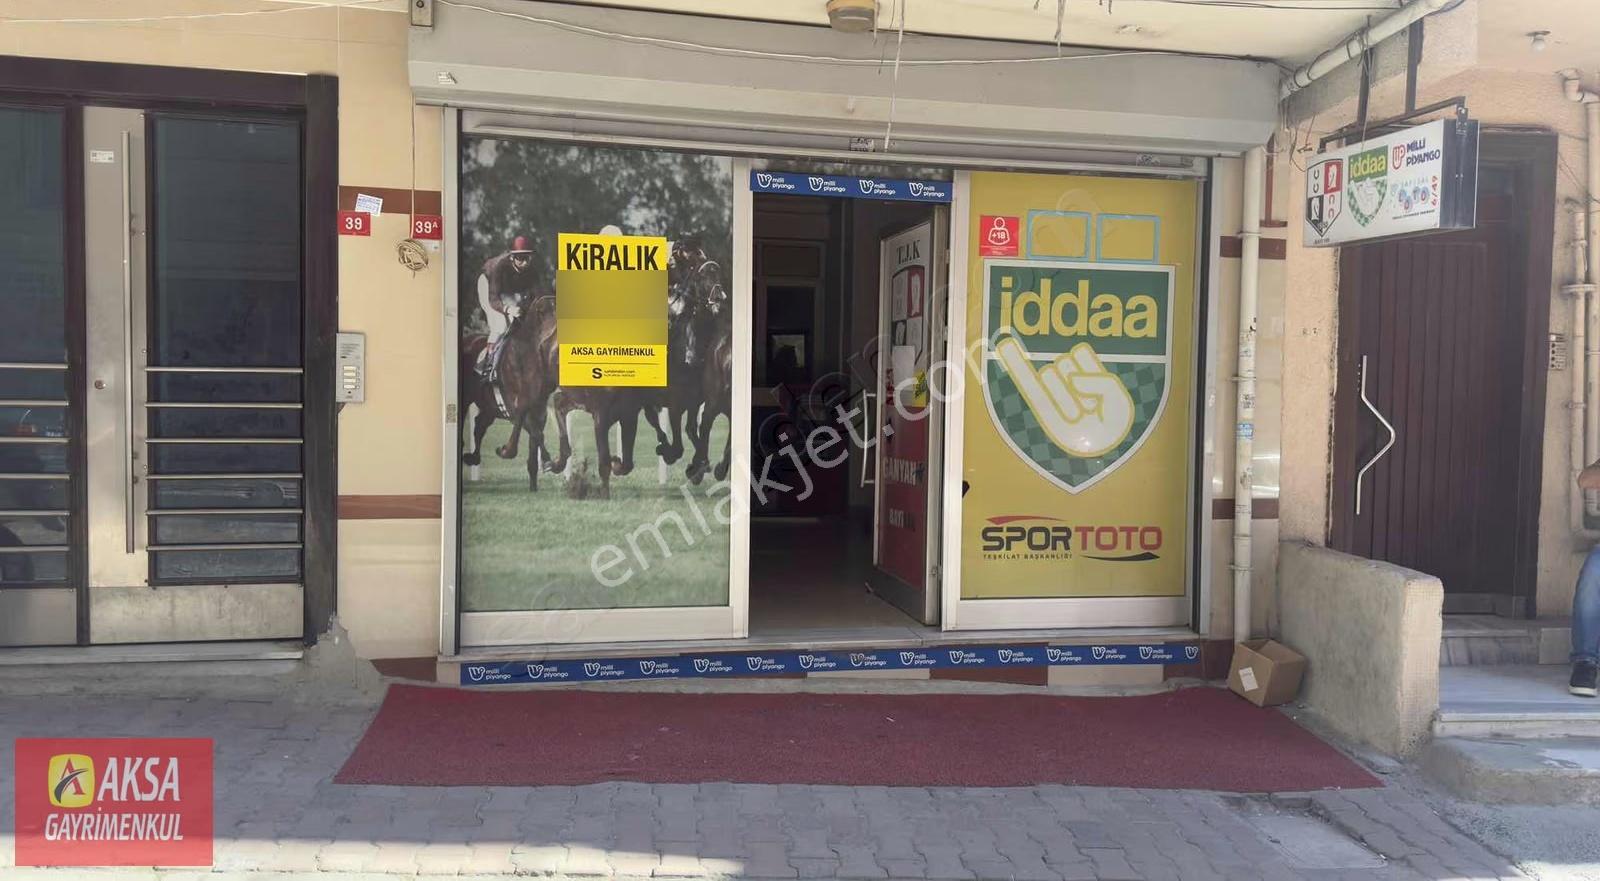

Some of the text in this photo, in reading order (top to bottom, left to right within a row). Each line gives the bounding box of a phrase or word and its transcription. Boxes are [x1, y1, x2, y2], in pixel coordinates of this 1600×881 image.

[1350, 153, 1386, 178] iddaa
[345, 217, 363, 230] 39
[991, 231, 1006, 240] +18
[1000, 276, 1158, 339] iddaa
[571, 346, 656, 357] AKSA GAYRİMENKUL
